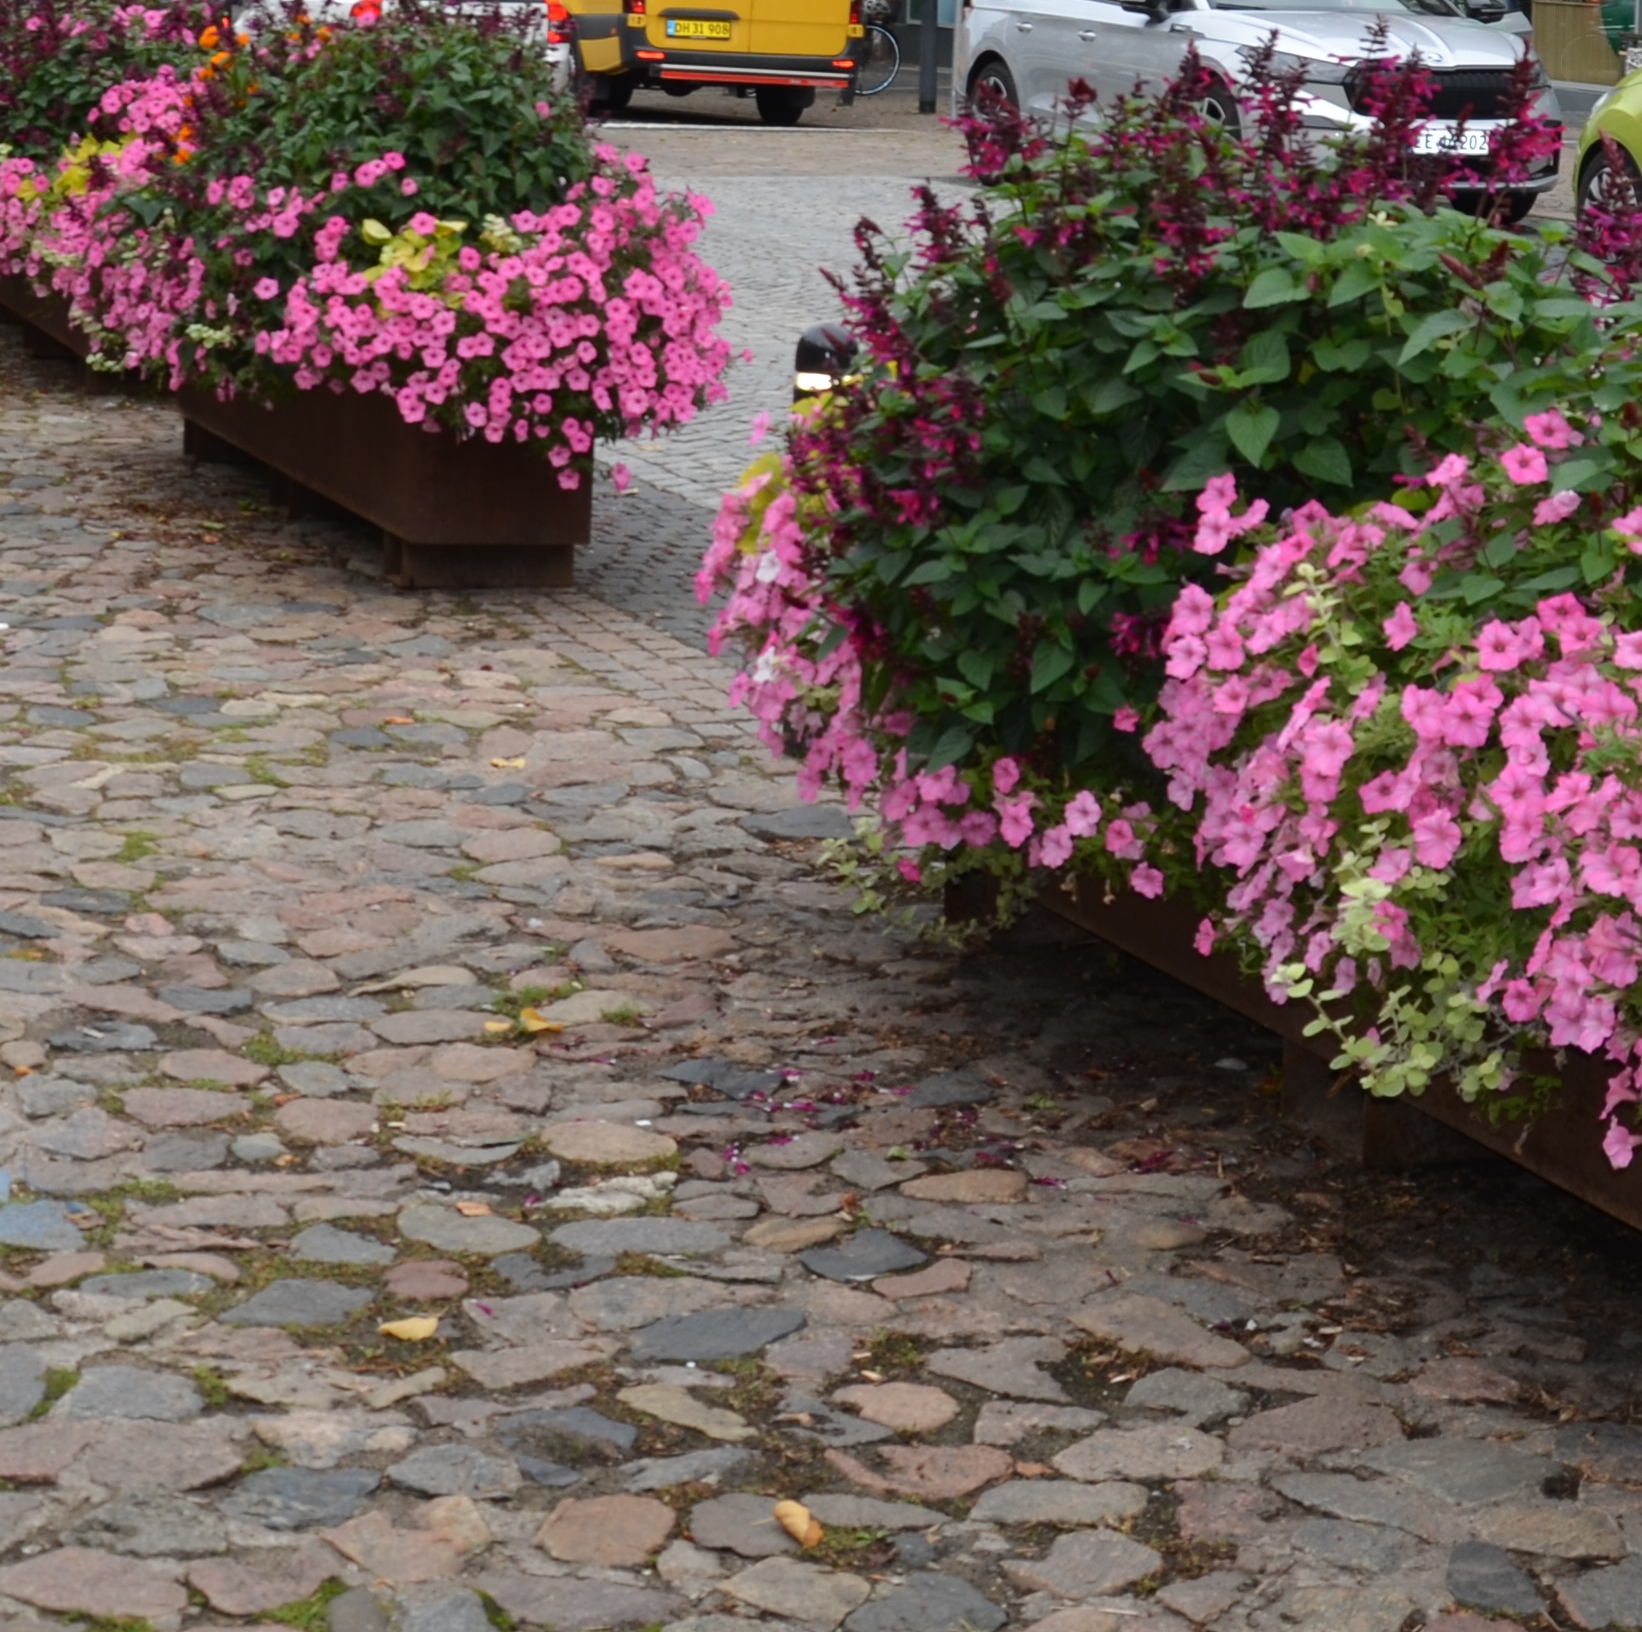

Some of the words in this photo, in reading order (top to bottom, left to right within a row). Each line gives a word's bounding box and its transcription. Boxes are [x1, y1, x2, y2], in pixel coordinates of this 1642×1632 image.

[675, 22, 690, 34] DH
[693, 23, 704, 34] 31
[708, 24, 729, 35] 908
